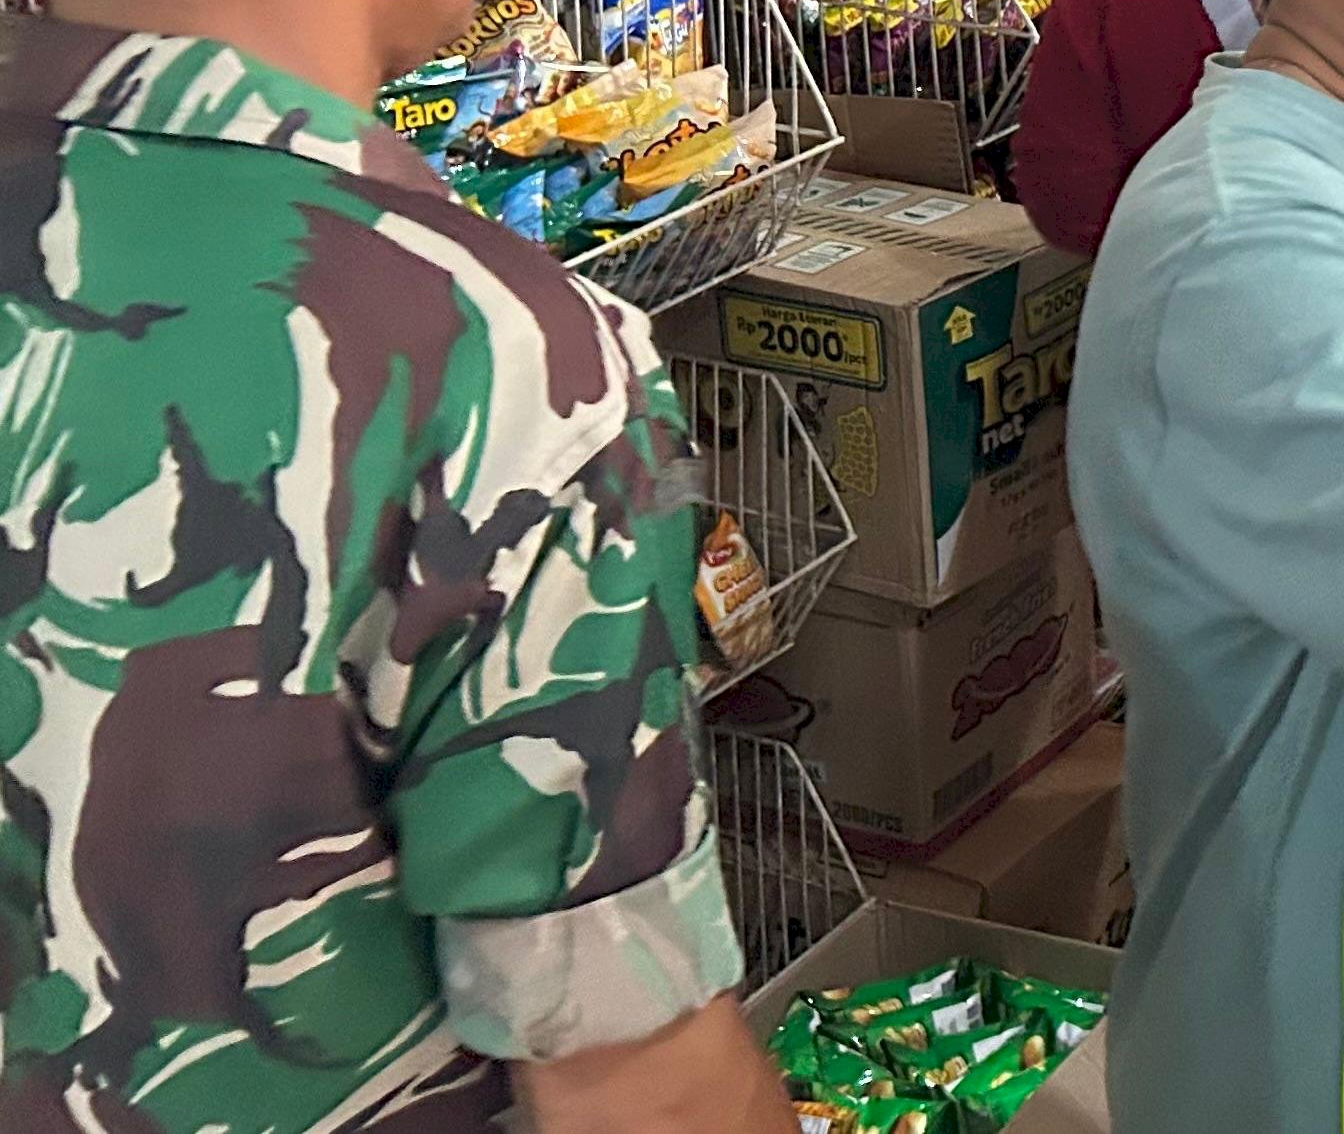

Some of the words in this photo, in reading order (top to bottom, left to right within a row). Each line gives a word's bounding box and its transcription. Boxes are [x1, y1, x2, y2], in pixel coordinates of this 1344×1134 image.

[391, 95, 457, 133] Taro
[757, 320, 844, 363] 2000
[981, 415, 1025, 455] net
